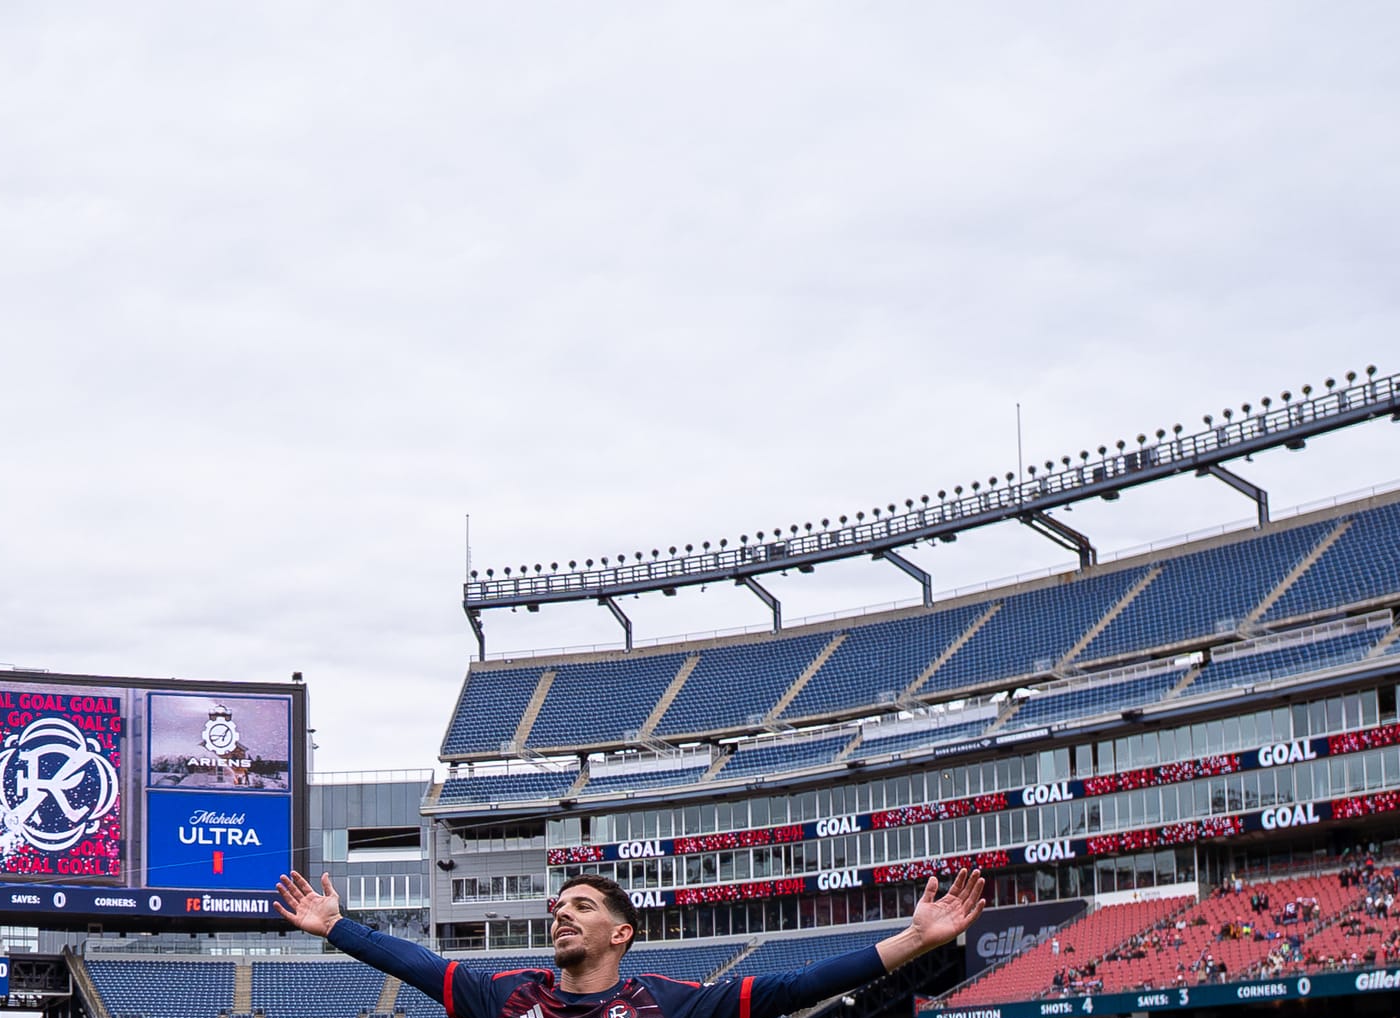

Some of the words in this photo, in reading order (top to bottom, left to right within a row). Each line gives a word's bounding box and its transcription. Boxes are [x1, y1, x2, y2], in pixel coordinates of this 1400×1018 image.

[19, 694, 66, 711] GOAL
[70, 696, 117, 714] GOAL
[187, 757, 252, 768] ARIENS
[618, 840, 665, 859] GOAL
[816, 816, 861, 838] GOAL
[1022, 783, 1074, 806] GOAL
[1258, 740, 1317, 768] GOAL
[189, 810, 246, 825] Michelob
[179, 826, 261, 846] ULTRA
[630, 891, 666, 909] OAL
[817, 869, 863, 891] GOAL
[1024, 841, 1076, 864] GOAL
[1261, 803, 1320, 830] GOAL
[58, 858, 105, 875] GOAL
[11, 893, 40, 904] SAVES:
[53, 891, 66, 908] 0
[95, 896, 136, 908] CORNERS:
[149, 895, 162, 911] 0
[186, 897, 201, 912] FC
[202, 898, 269, 913] CINCINNATI
[1040, 1003, 1072, 1016] SHOTS:
[1082, 997, 1093, 1014] 4
[1137, 994, 1168, 1008] SAVES:
[1179, 988, 1189, 1006] 3
[1237, 983, 1287, 999] CORNERS:
[1297, 977, 1311, 996] 0
